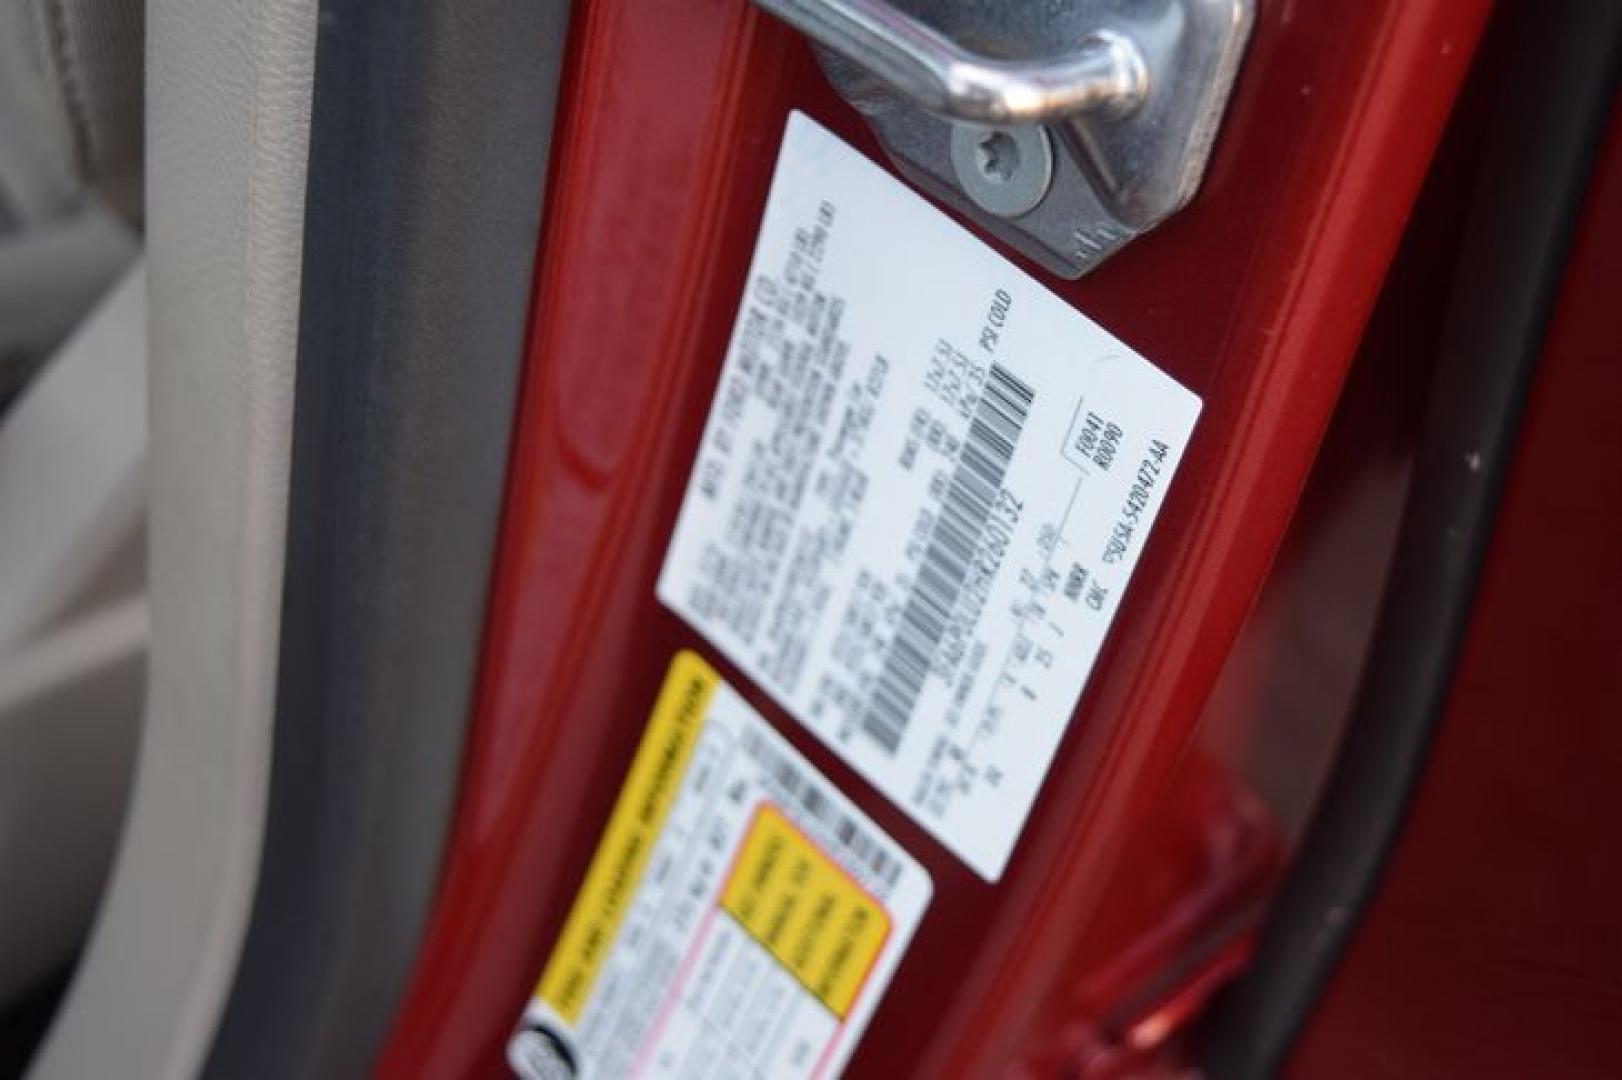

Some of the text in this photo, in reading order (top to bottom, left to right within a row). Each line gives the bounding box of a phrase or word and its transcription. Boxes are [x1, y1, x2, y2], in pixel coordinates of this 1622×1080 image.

[986, 287, 1012, 328] COLD
[737, 306, 768, 376] MOTOR
[978, 324, 999, 353] PSI
[1091, 421, 1123, 471] R0090
